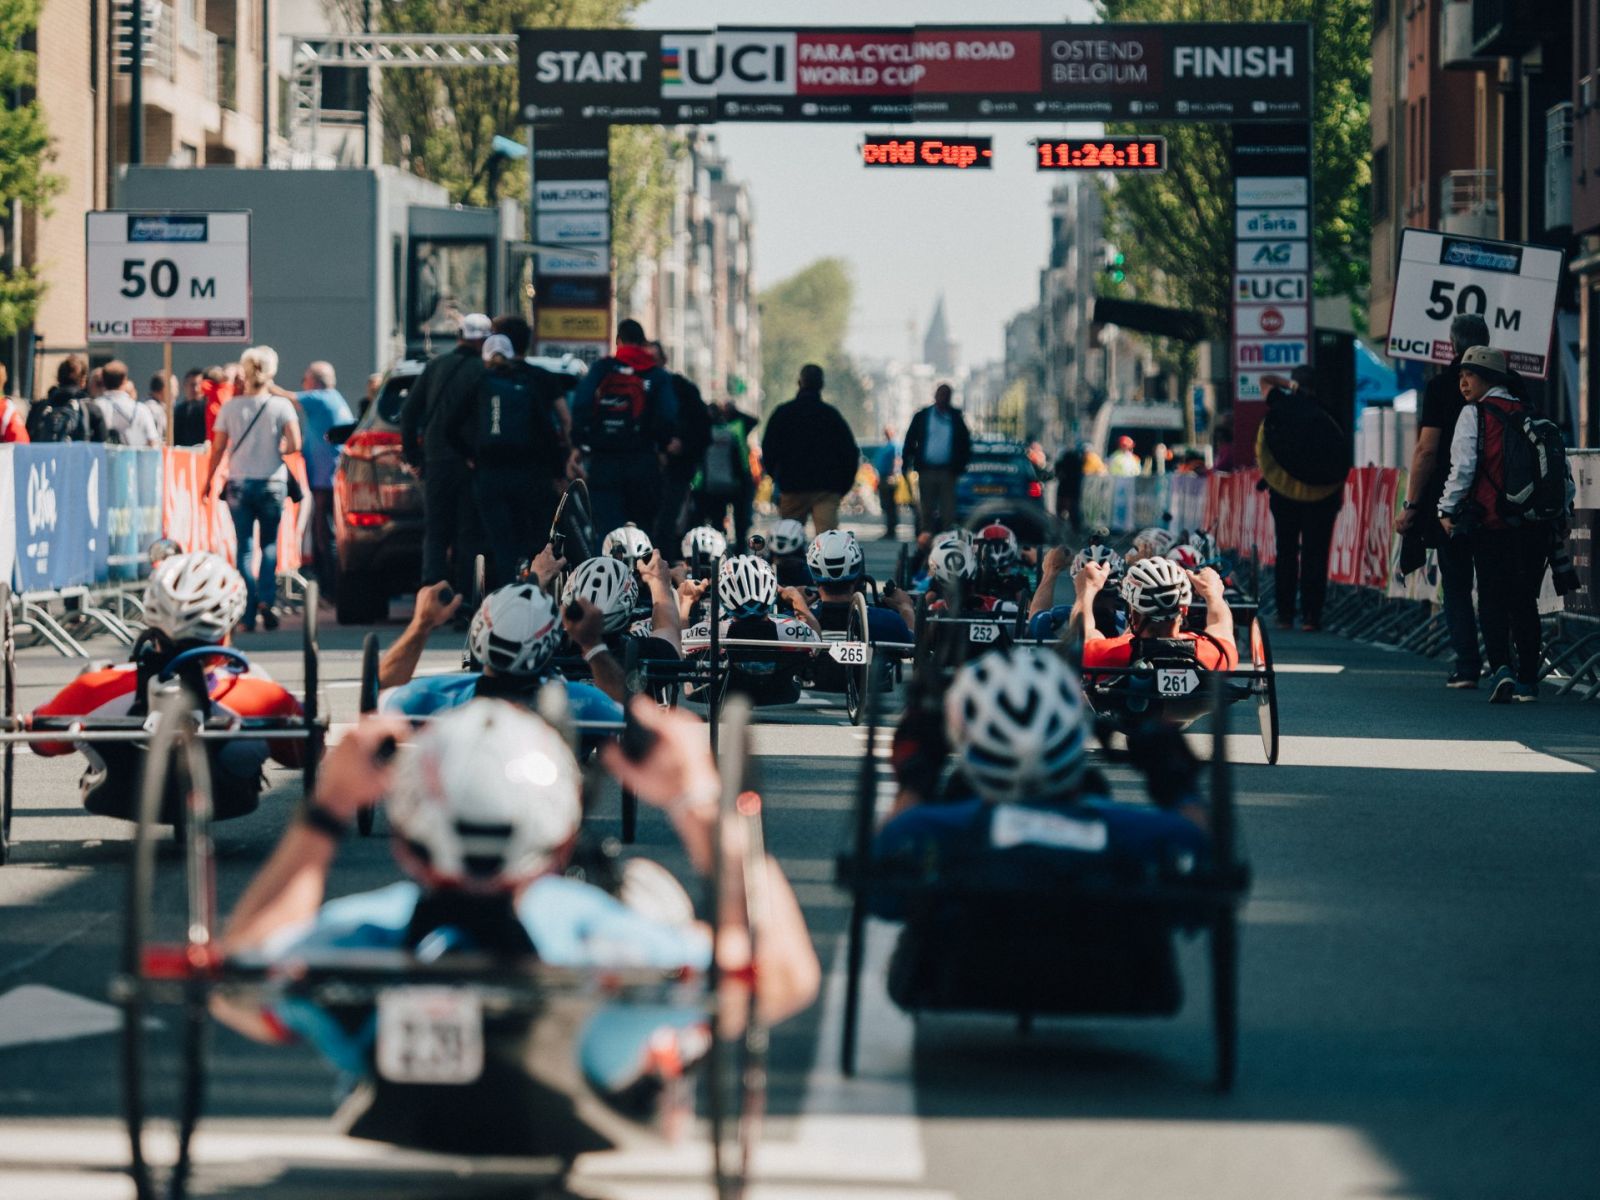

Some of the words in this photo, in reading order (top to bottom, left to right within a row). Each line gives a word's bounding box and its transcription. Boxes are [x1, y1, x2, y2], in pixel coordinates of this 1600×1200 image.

[799, 41, 950, 63] PARA-CYCLING
[954, 41, 1015, 60] ROAD
[1051, 40, 1144, 61] OSTEND
[535, 50, 647, 83] START
[687, 44, 786, 85] UCI
[1174, 46, 1294, 77] FINISH
[799, 65, 879, 85] WORLD
[882, 64, 926, 85] CUP
[1052, 63, 1148, 83] BELGIUM
[921, 141, 977, 168] Cup
[1038, 143, 1159, 167] 11:24:11
[120, 259, 179, 298] 50
[191, 278, 216, 298] M
[1252, 279, 1303, 298] UCI
[1425, 280, 1487, 321] 50
[1494, 307, 1521, 331] M
[97, 321, 129, 335] UCI
[1397, 339, 1430, 355] UCI
[972, 626, 992, 641] 252
[840, 647, 863, 662] 265
[1163, 675, 1188, 692] 261
